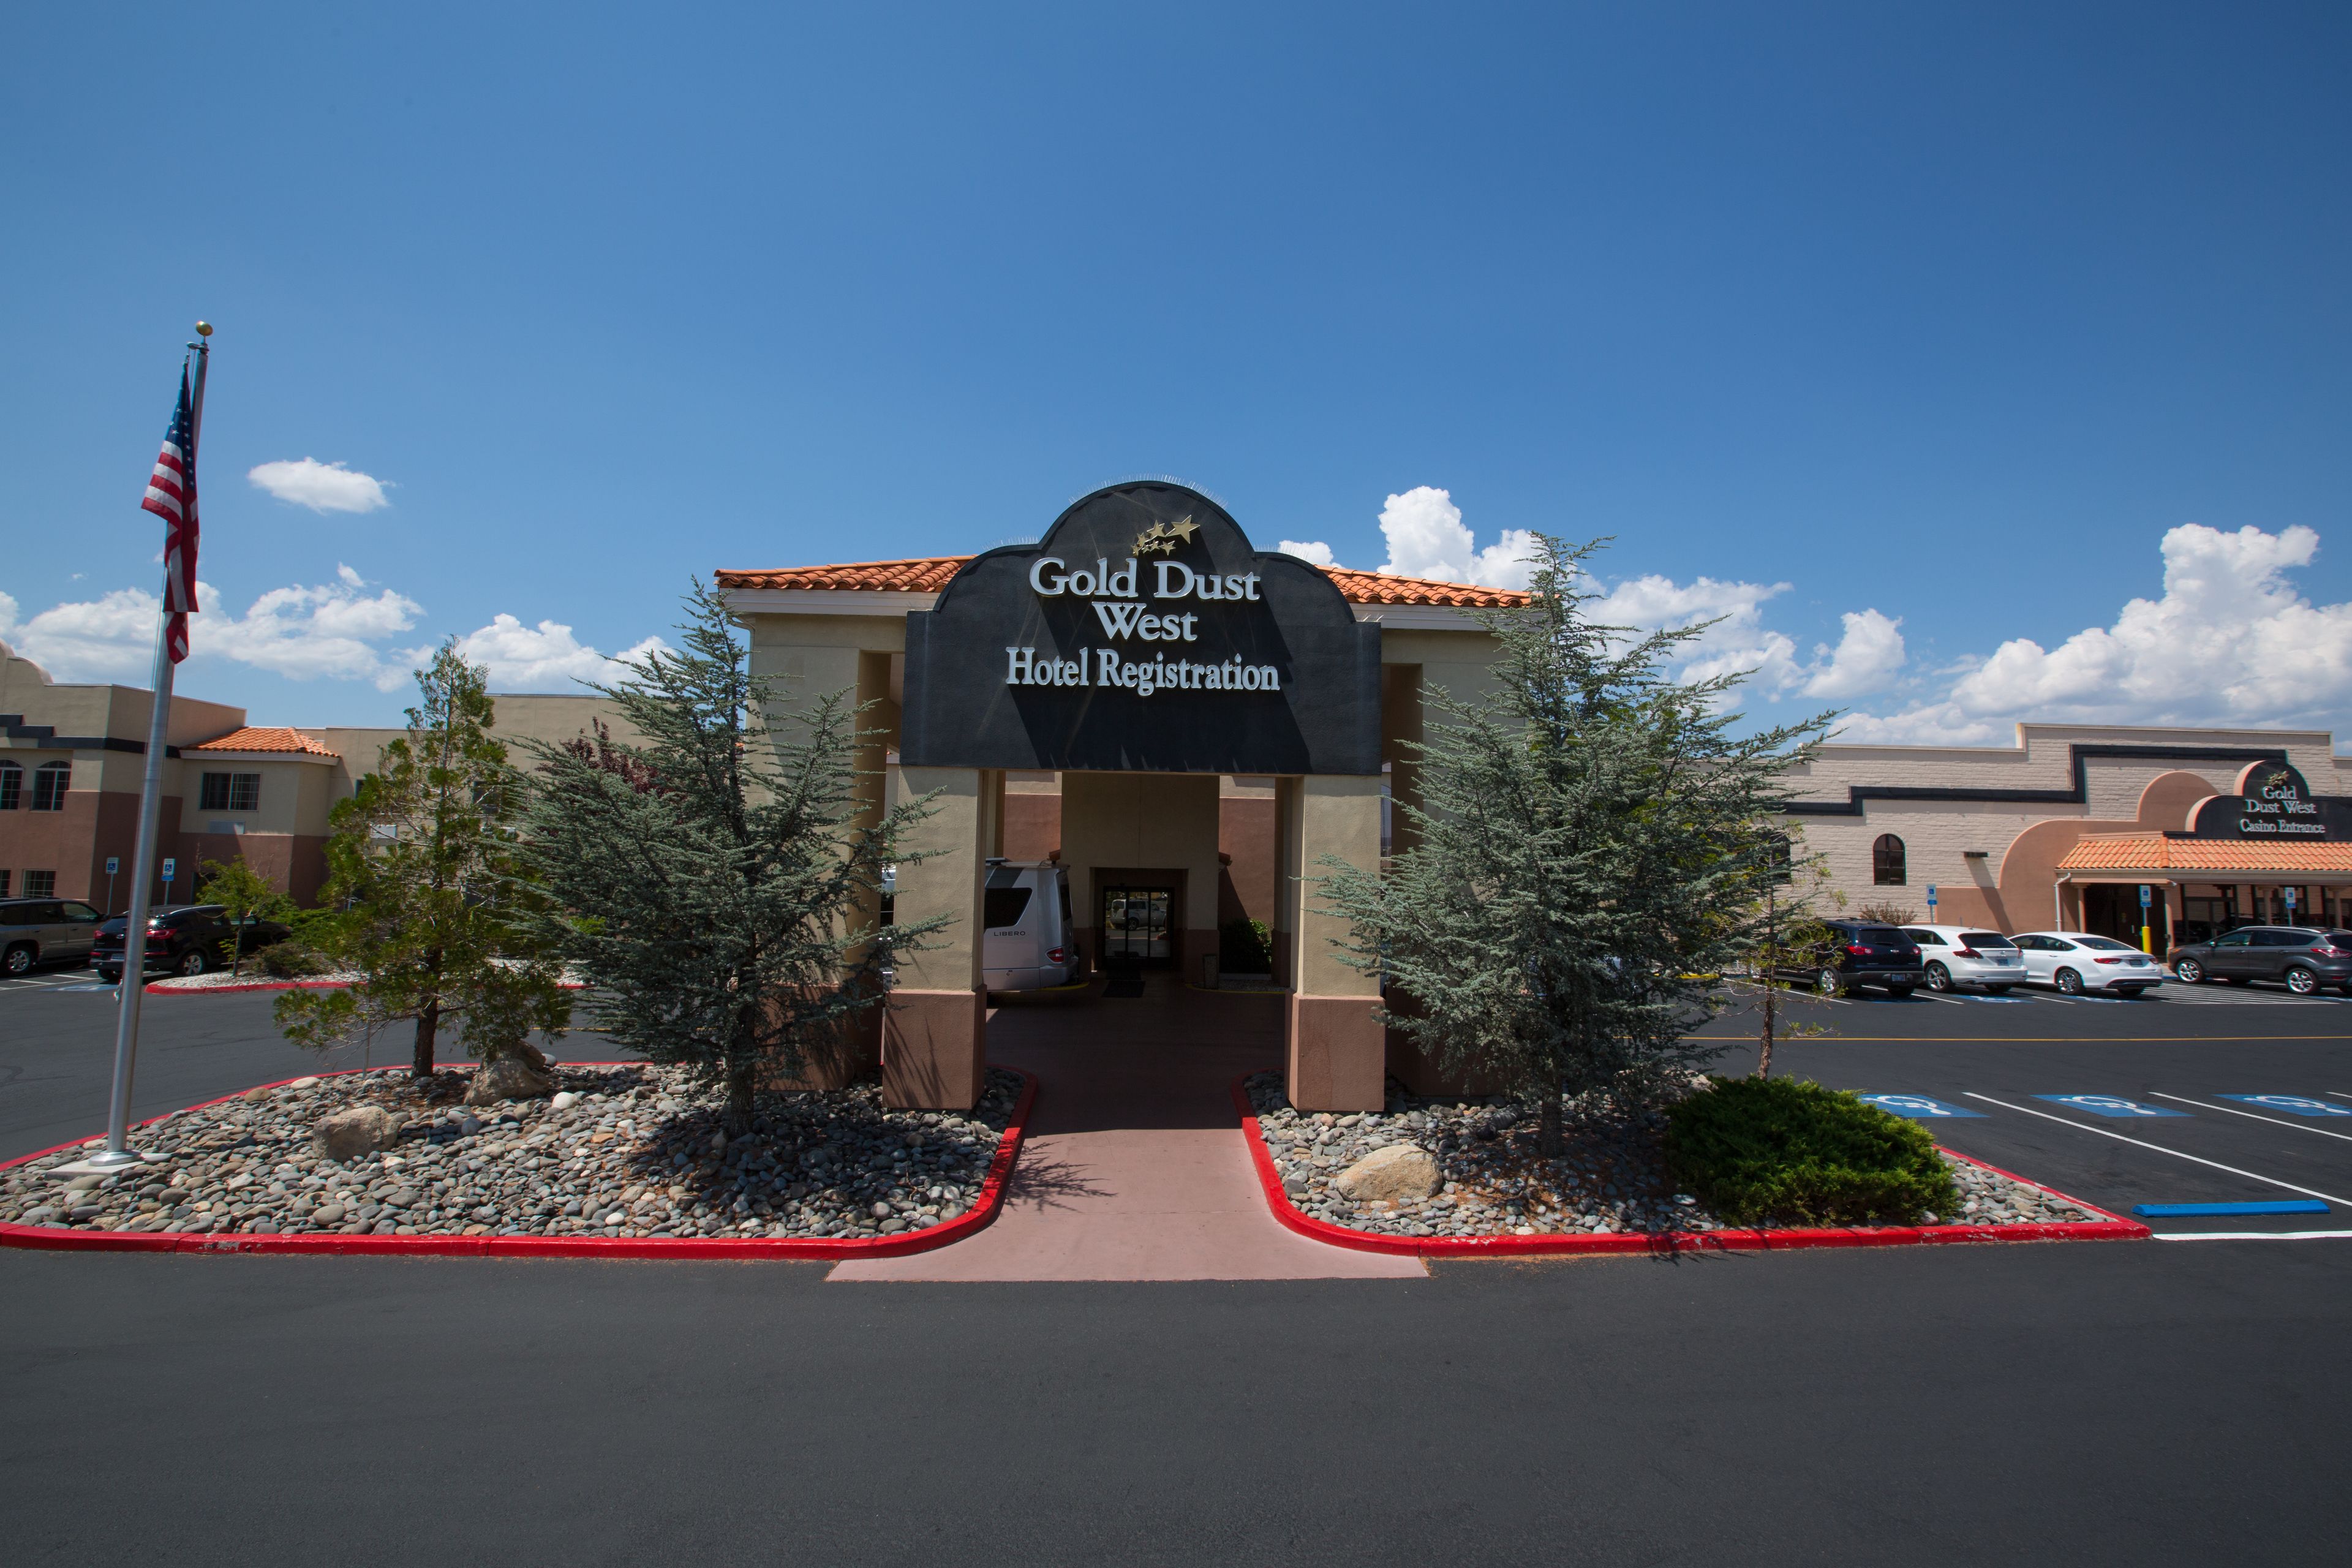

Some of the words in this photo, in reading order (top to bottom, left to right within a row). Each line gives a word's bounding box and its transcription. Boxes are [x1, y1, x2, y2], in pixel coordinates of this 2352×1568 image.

[1029, 557, 1138, 598] Gold
[1153, 560, 1261, 602] Dust
[1091, 601, 1198, 642] West
[1006, 646, 1090, 687] Hotel
[1096, 649, 1280, 697] Registration
[2262, 785, 2297, 799] Gold
[2245, 799, 2280, 813] Dust
[2283, 800, 2317, 814] West
[2239, 818, 2277, 832] Casino
[2277, 819, 2326, 834] Entrance
